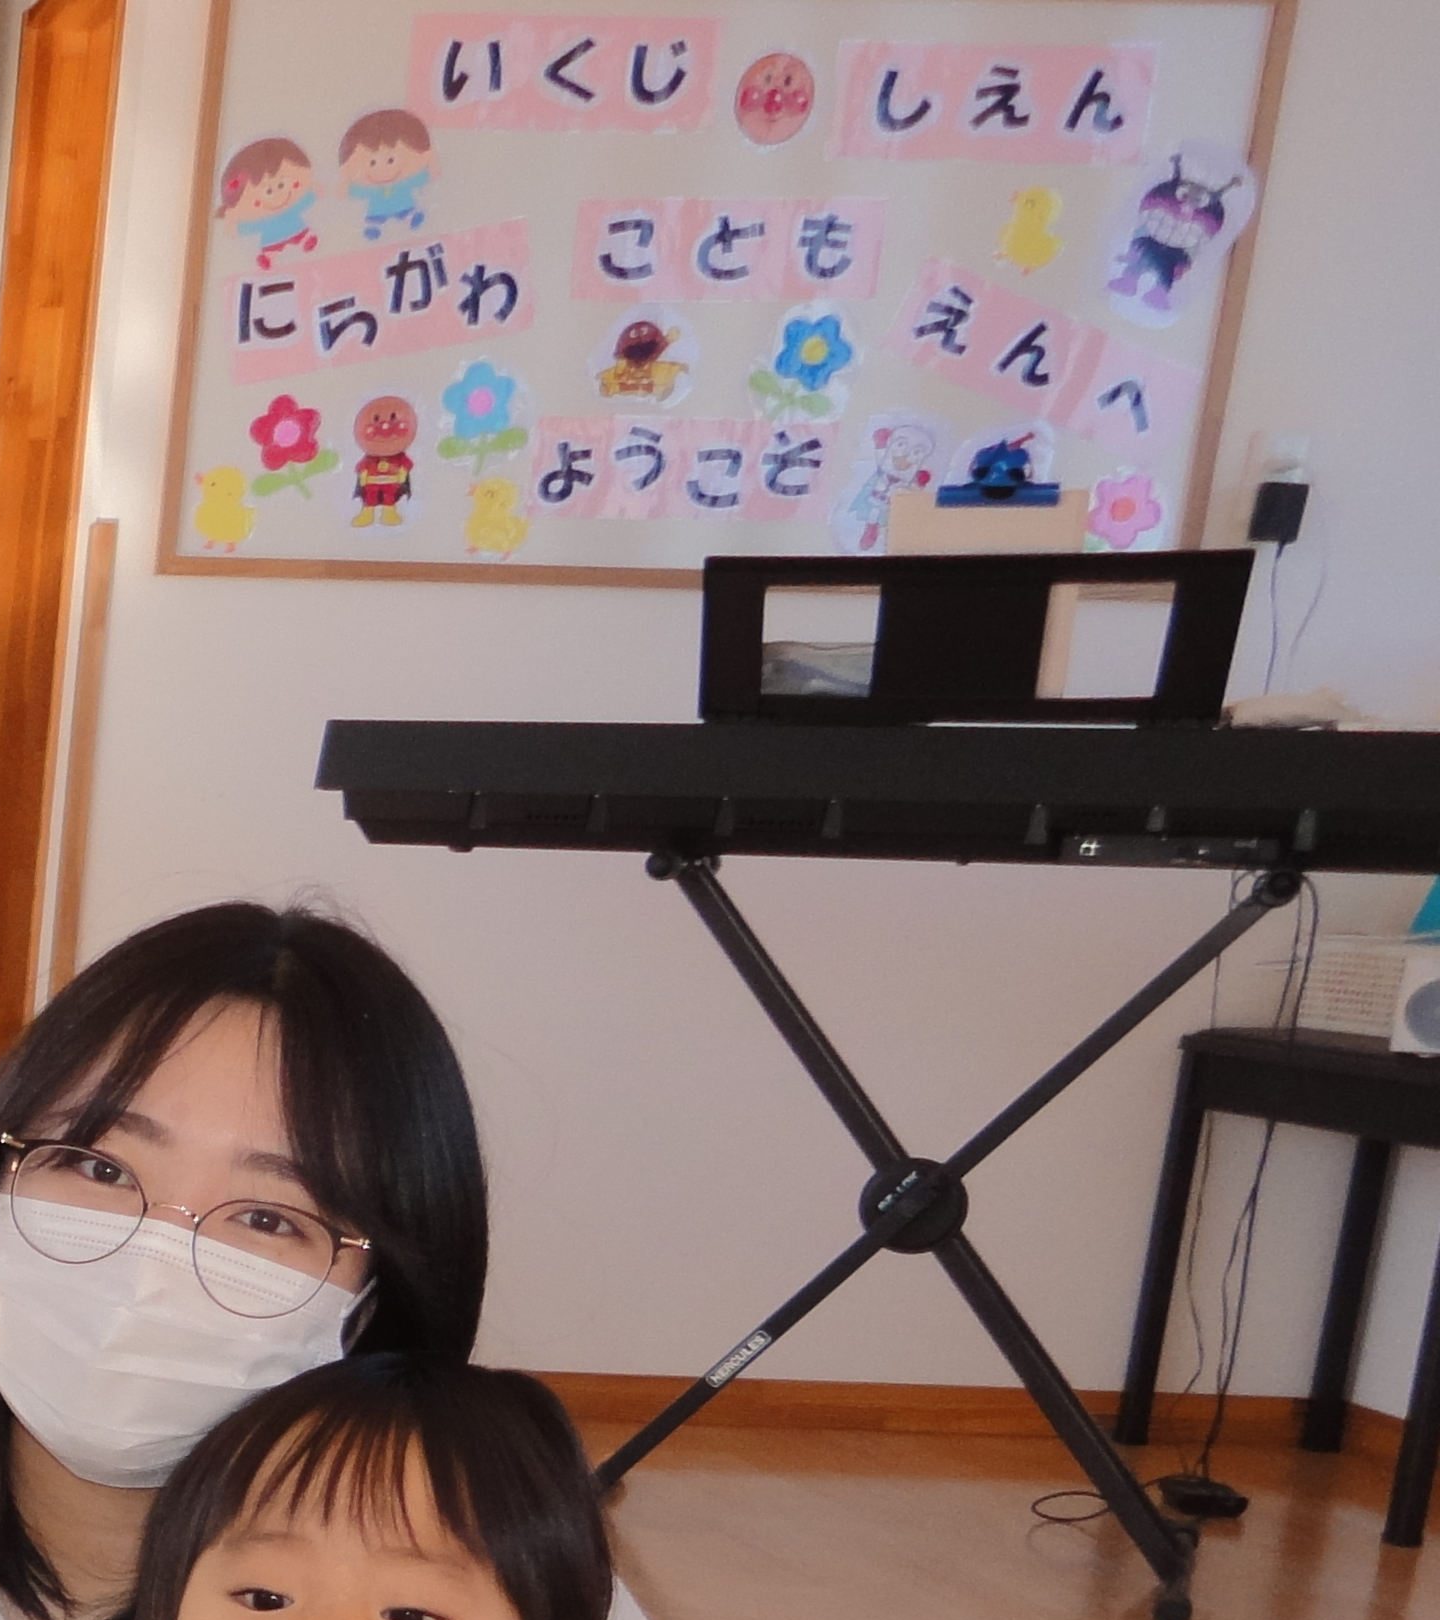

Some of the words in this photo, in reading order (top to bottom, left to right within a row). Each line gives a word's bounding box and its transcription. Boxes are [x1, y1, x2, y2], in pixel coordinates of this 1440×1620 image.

[442, 38, 689, 103] いくじ
[877, 66, 1126, 134] しえん
[238, 249, 518, 348] にらがわ
[598, 212, 858, 283] こども
[537, 428, 827, 510] ようこそ
[709, 1334, 766, 1384] HERCULES
